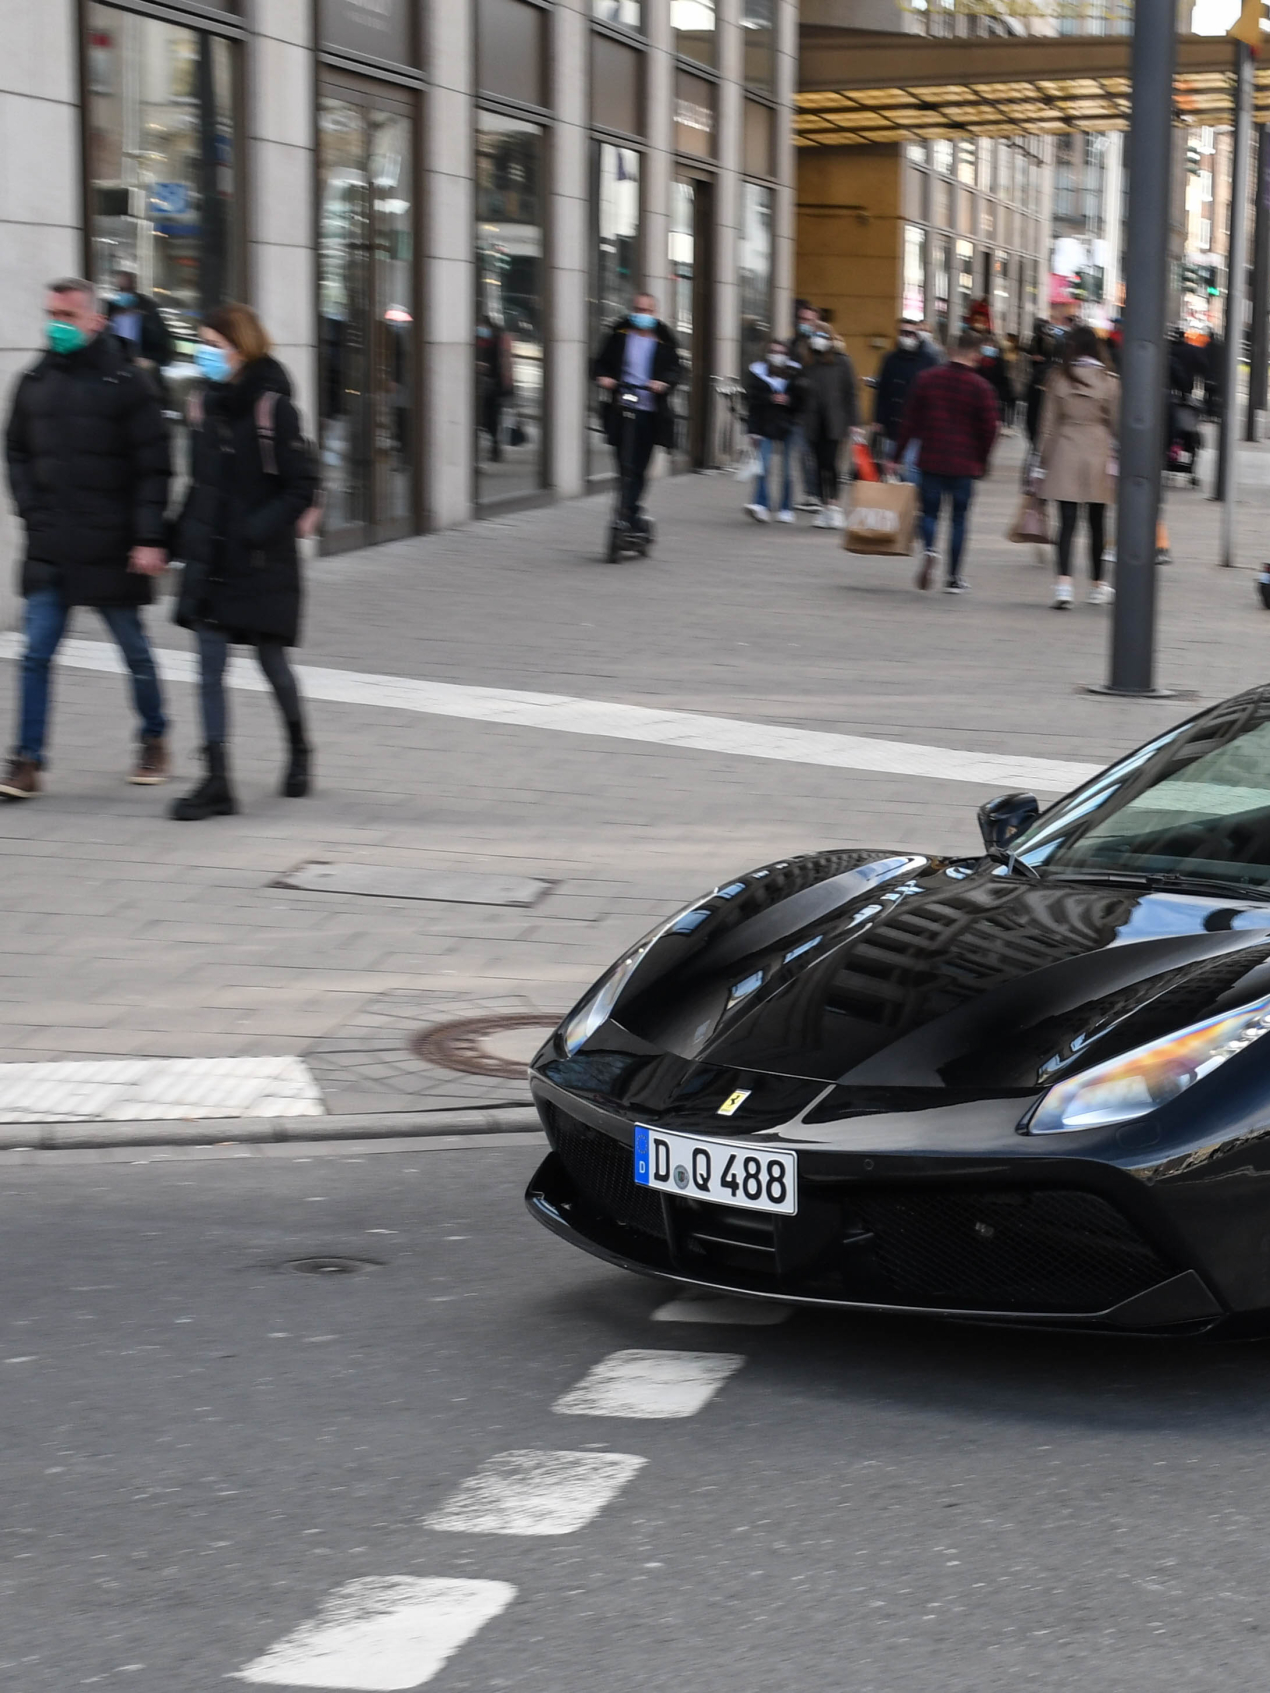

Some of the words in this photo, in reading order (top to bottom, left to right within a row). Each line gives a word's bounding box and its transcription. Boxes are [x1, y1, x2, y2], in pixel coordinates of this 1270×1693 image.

[639, 1160, 646, 1174] D
[653, 1137, 670, 1183] D
[692, 1147, 711, 1193] Q
[720, 1153, 787, 1205] 488
